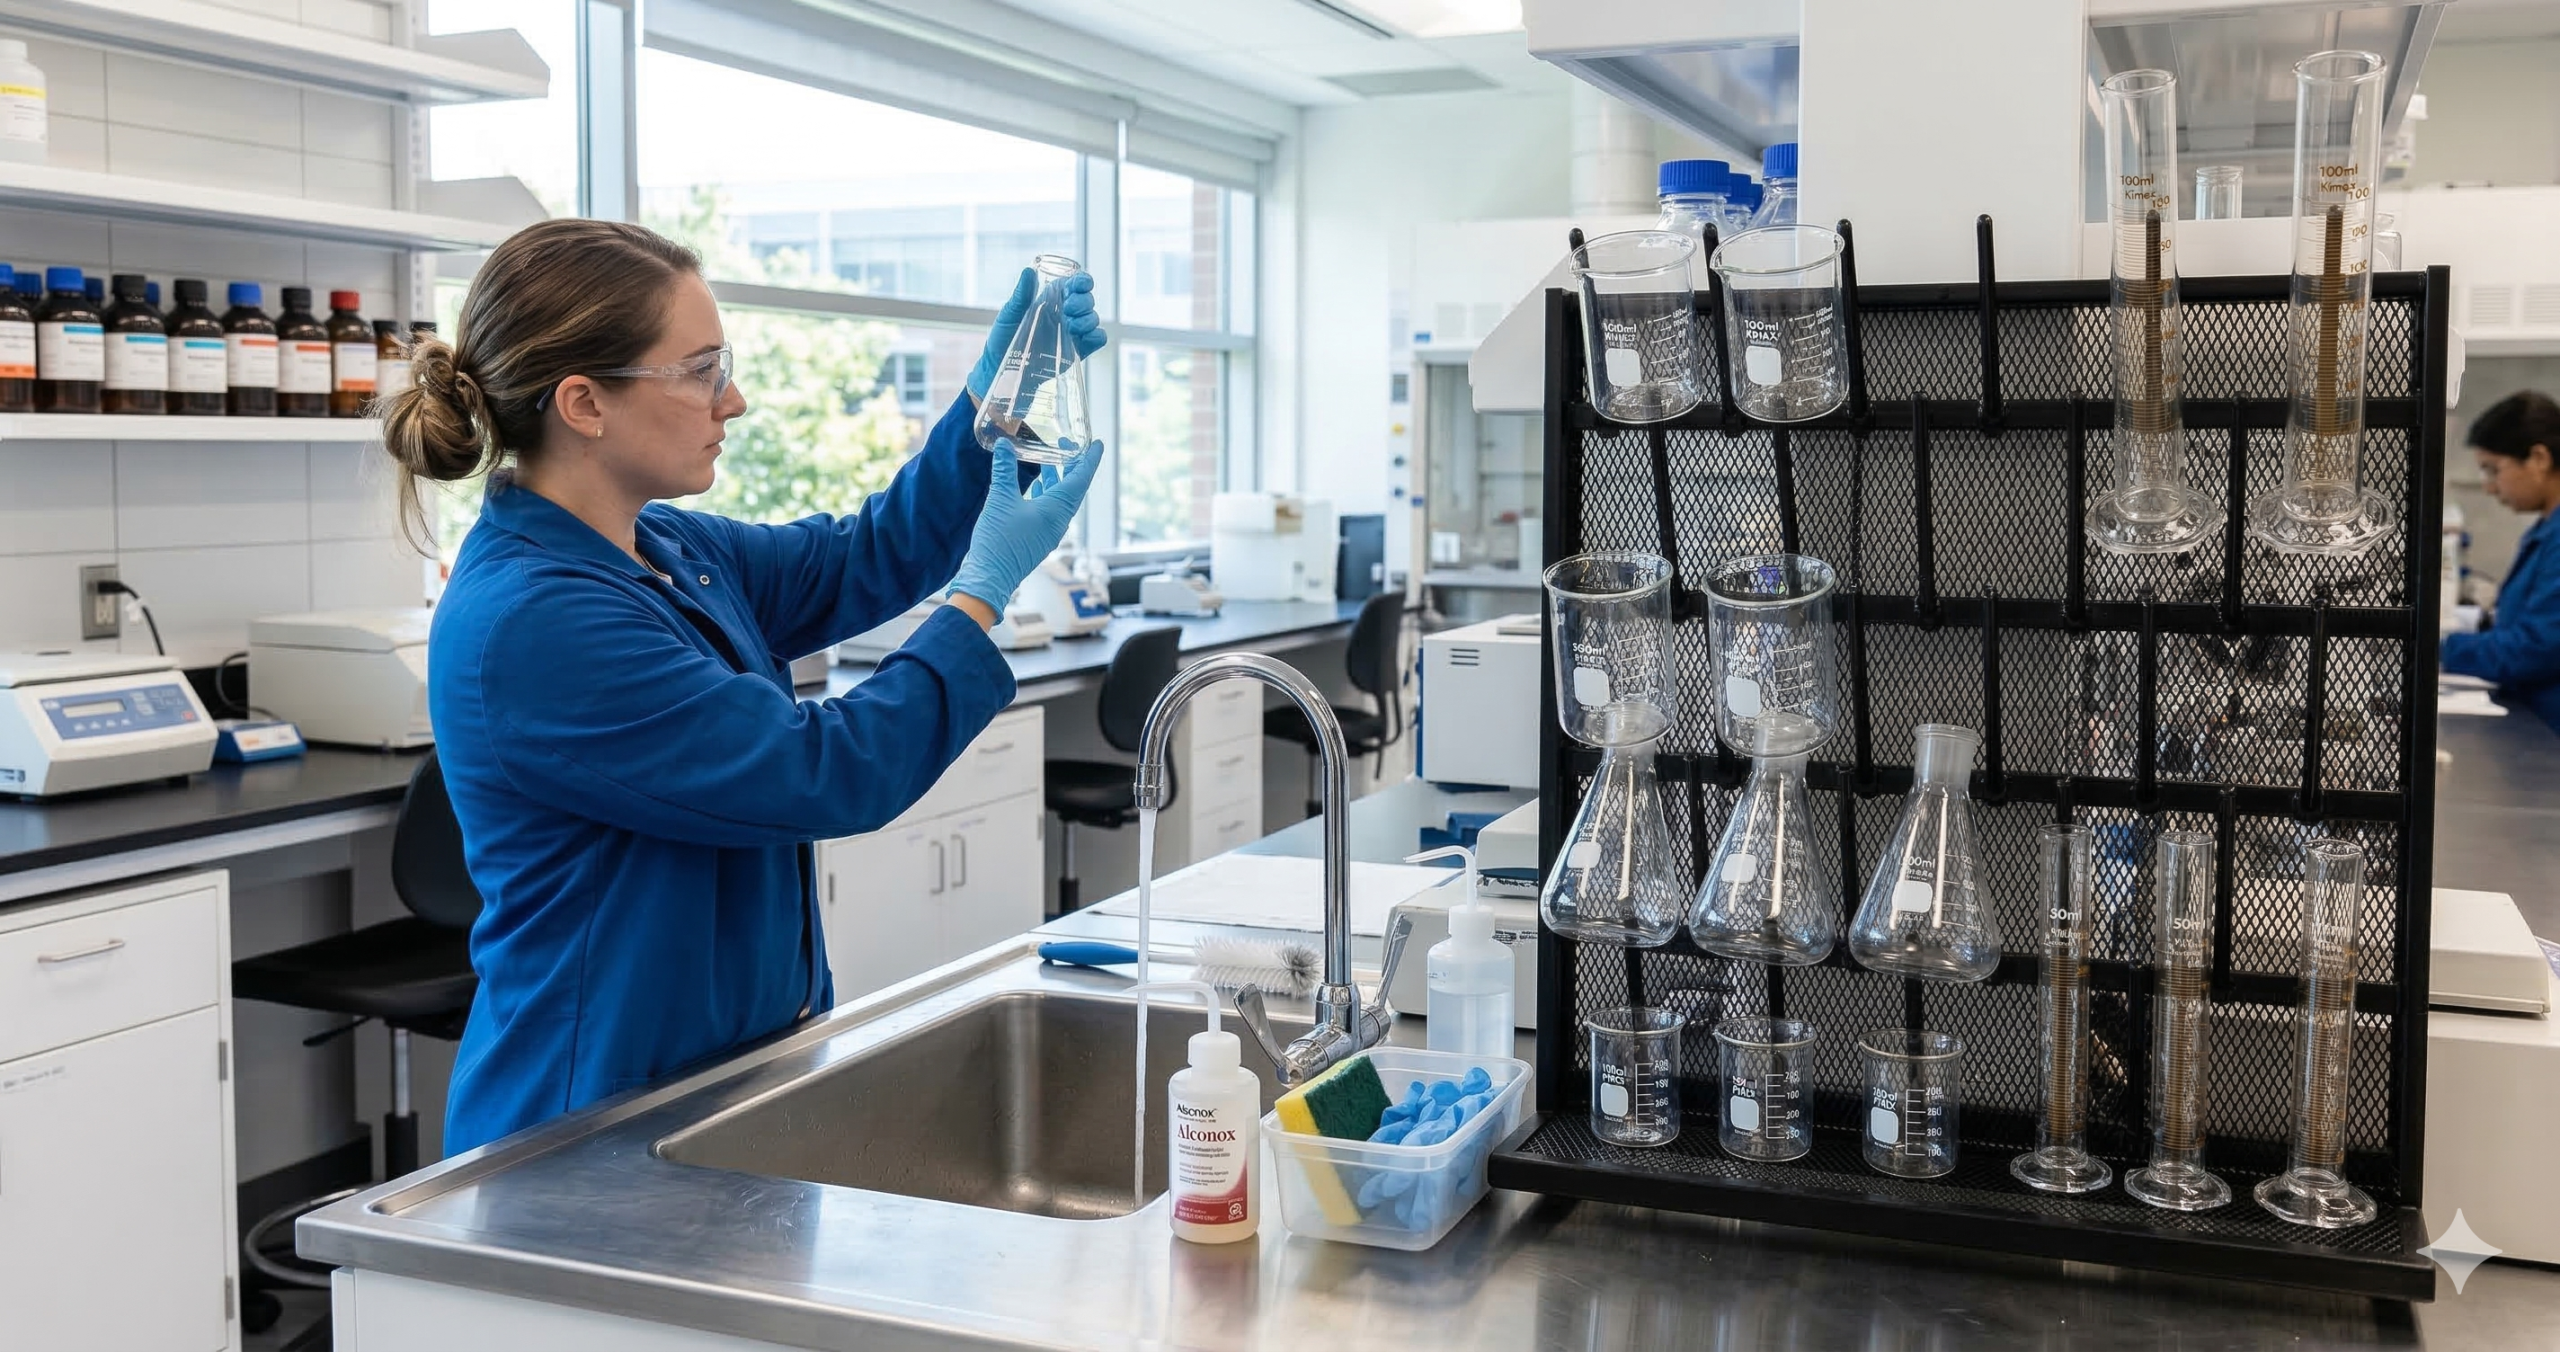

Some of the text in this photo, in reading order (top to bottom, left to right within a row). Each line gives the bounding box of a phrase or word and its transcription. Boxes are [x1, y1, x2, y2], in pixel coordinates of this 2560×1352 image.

[2319, 164, 2358, 177] 100ml
[2120, 173, 2154, 186] 100ml
[2348, 187, 2370, 200] 100
[1744, 319, 1780, 331] 100ml
[1177, 1123, 1236, 1142] Alconox
